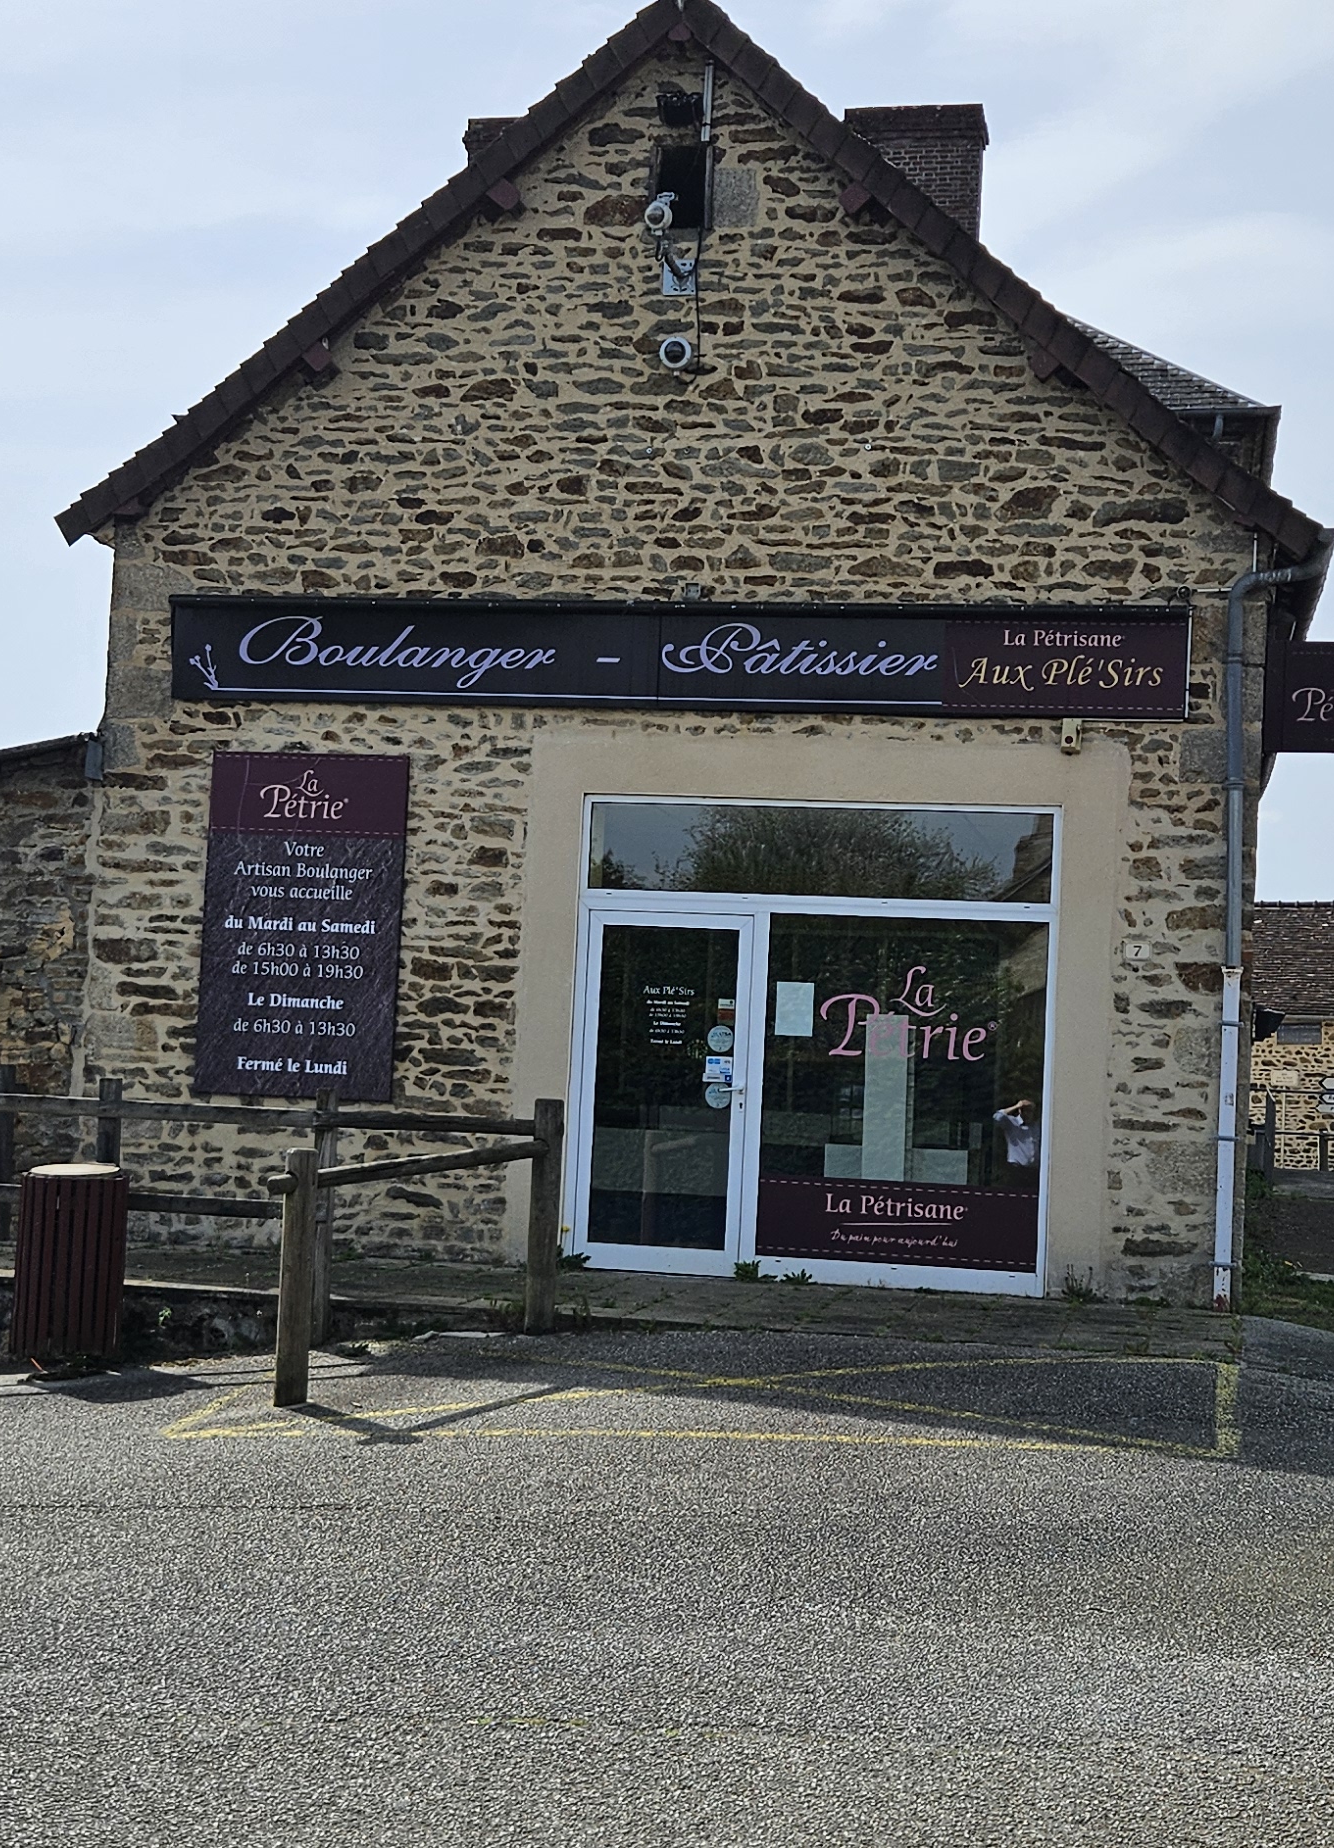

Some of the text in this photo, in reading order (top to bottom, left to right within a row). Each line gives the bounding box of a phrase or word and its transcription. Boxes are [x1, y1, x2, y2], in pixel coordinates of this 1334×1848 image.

[1003, 629, 1122, 647] La Pétrisane
[238, 615, 555, 688] Boulanger
[661, 622, 939, 676] Pâtissier
[958, 657, 1035, 691] Aux
[298, 769, 324, 797] La
[259, 785, 344, 820] Pétrie
[284, 841, 325, 858] Votre
[234, 861, 373, 885] Artisan Boulanger
[251, 885, 353, 901] vous accueille
[224, 915, 376, 935] du Mardi au Samedi
[237, 942, 360, 960] de 6h30 à 13h30
[1133, 945, 1142, 957] 7
[232, 961, 364, 980] de 15h00 à 19h30
[643, 985, 661, 995] Aux
[889, 966, 947, 1017] La
[247, 992, 344, 1010] Le Dimanche
[233, 1019, 356, 1037] de 6h30 à 13h30
[237, 1056, 348, 1075] Fermé le Lundi
[825, 1193, 965, 1220] La Pétrisane
[830, 1228, 846, 1241] Du
[847, 1233, 870, 1245] pain
[871, 1234, 896, 1245] pour
